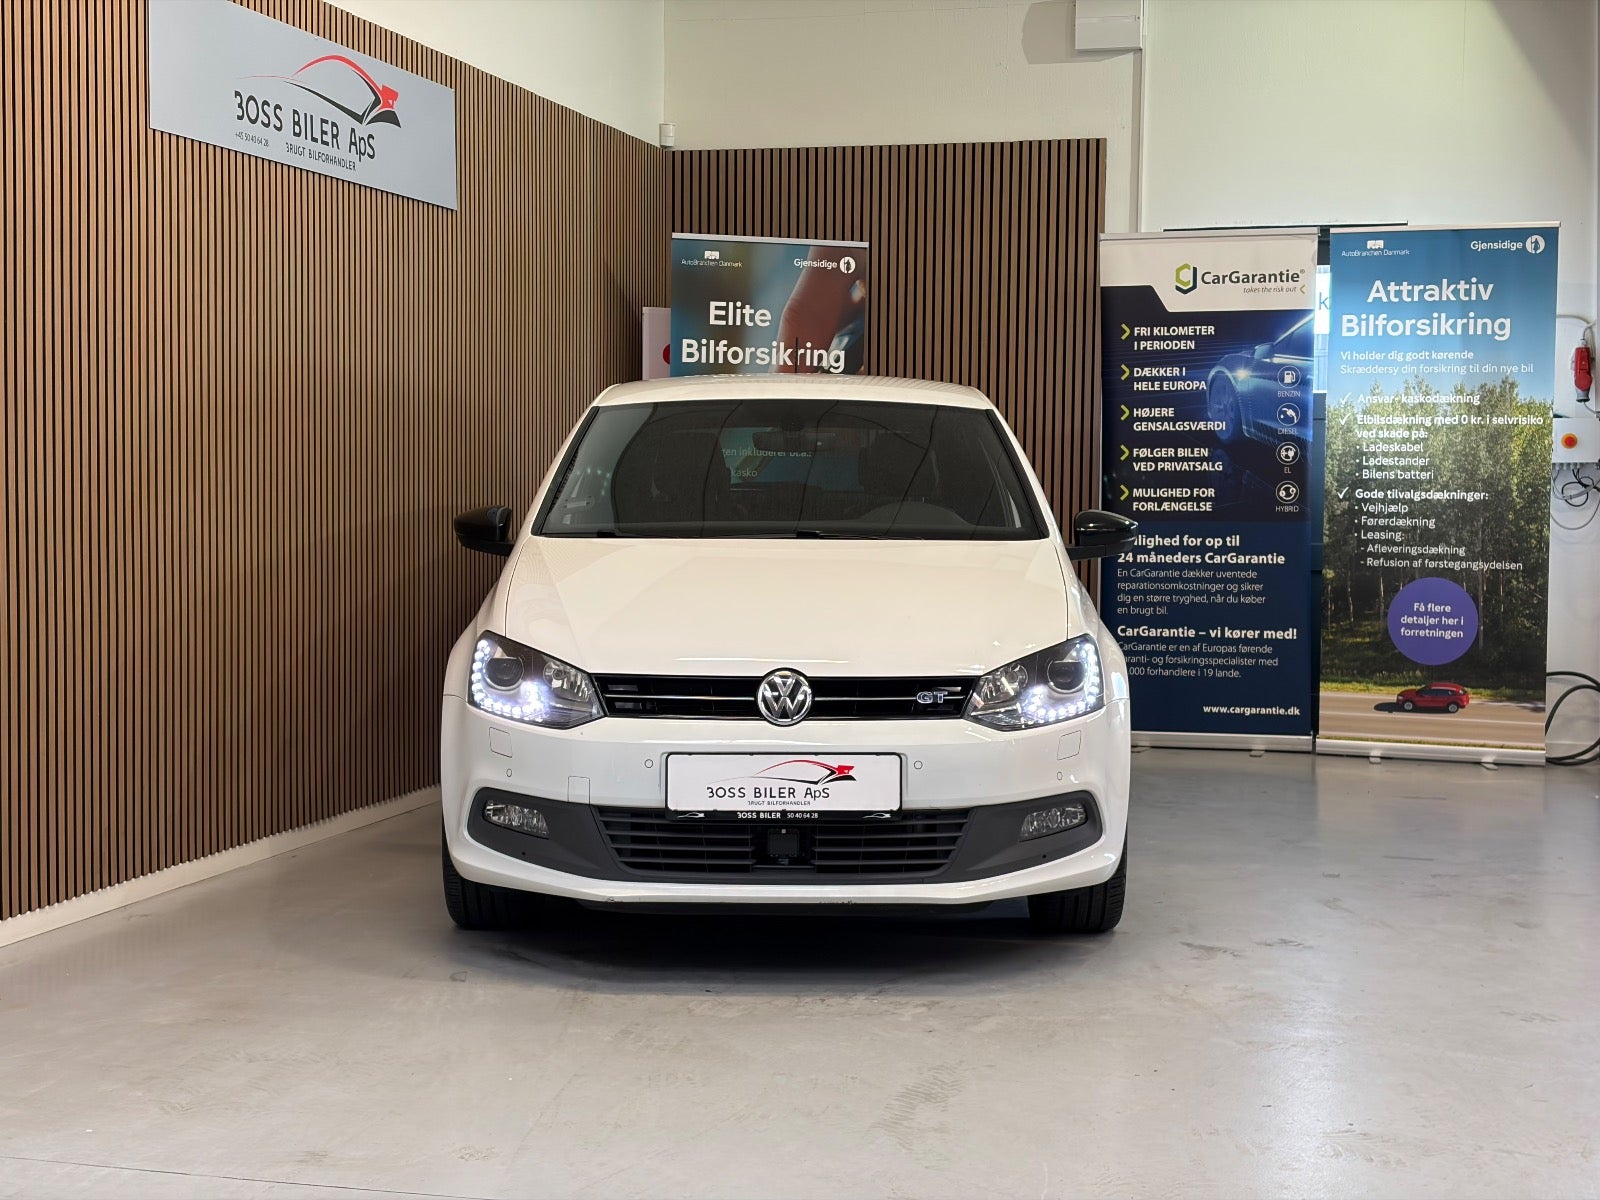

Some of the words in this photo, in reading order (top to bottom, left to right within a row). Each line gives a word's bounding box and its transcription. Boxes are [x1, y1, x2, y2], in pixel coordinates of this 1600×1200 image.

[234, 131, 243, 140] +45
[244, 133, 250, 142] 50
[257, 137, 262, 145] 64
[292, 108, 340, 150] BILER
[349, 127, 376, 162] ApS
[308, 149, 356, 171] BILFORHANDLER
[1470, 240, 1522, 251] Gjensidige
[794, 259, 837, 269] Gjensidige
[1367, 277, 1494, 303] Attraktiv
[709, 301, 771, 326] Elite
[1134, 327, 1150, 337] FRI
[1154, 326, 1214, 336] KILOMETER
[1341, 312, 1511, 340] Bilforsikring
[1134, 341, 1137, 350] I
[1140, 340, 1195, 350] PERIODEN
[682, 339, 845, 373] Bilforsikring
[1341, 351, 1351, 360] Vi
[1353, 351, 1385, 360] holder
[1388, 351, 1403, 361] dig
[1406, 351, 1429, 361] godt
[1432, 351, 1473, 359] kørende
[1134, 368, 1180, 377] DÆKKER
[1183, 368, 1185, 376] I
[1340, 365, 1398, 374] Skræddersy
[1402, 364, 1416, 373] din
[1419, 364, 1466, 374] forsikring
[1470, 364, 1479, 373] til
[1482, 364, 1497, 373] din
[1500, 366, 1518, 374] nye
[1521, 364, 1533, 373] bil
[1134, 382, 1160, 391] HELE
[1163, 381, 1206, 390] EUROPA
[1401, 394, 1480, 405] kaskodækning
[1133, 408, 1174, 418] HØJERE
[1357, 415, 1431, 426] Elbilsdækning
[1434, 415, 1458, 425] med
[1461, 415, 1468, 425] 0
[1471, 415, 1484, 425] kr.
[1486, 415, 1489, 424] i
[1493, 415, 1543, 425] selvrisiko
[1133, 422, 1225, 431] GENSALGSVÆRDI
[1357, 429, 1375, 438] ved
[1378, 429, 1408, 438] skade
[1412, 428, 1428, 440] på:
[1363, 442, 1423, 452] Ladeskabel
[1133, 448, 1175, 458] FØLGER
[1178, 448, 1208, 457] BILEN
[1133, 462, 1155, 471] VED
[1158, 462, 1223, 471] PRIVATSALG
[1363, 456, 1429, 466] Ladestander
[1363, 470, 1394, 479] Bilens
[1397, 470, 1434, 480] batteri
[1133, 488, 1190, 498] MULIGHED
[1194, 488, 1215, 497] FOR
[1356, 490, 1384, 499] Gode
[1387, 490, 1488, 502] tilvalgsdækninger:
[1133, 502, 1212, 512] FORLÆNGELSE
[1362, 503, 1408, 514] Vejhjælp
[1361, 517, 1435, 528] Førerdækning
[1361, 530, 1404, 540] Leasing:
[1183, 535, 1202, 546] for
[1206, 538, 1222, 549] op
[1226, 535, 1240, 546] til
[1367, 544, 1465, 556] Afleveringsdækning
[1118, 553, 1133, 563] 24
[1137, 552, 1201, 563] måneders
[1205, 553, 1285, 564] CarGarantie
[1367, 558, 1409, 568] Refusion
[1413, 559, 1422, 568] af
[1425, 559, 1522, 571] førstegangsydelsen
[1130, 569, 1180, 578] CarGarantie
[1182, 570, 1213, 578] dækker
[1216, 570, 1257, 579] uventede
[1118, 582, 1224, 592] reparationsomkostninger
[1118, 594, 1131, 603] dig
[1146, 594, 1170, 602] større
[1173, 594, 1208, 604] tryghed,
[1211, 595, 1224, 603] når
[1241, 595, 1265, 604] køber
[1131, 606, 1154, 616] brugt
[1156, 606, 1168, 615] bil.
[1414, 602, 1424, 612] Få
[1427, 603, 1451, 612] flere
[1401, 616, 1438, 626] detaljer
[1442, 616, 1458, 625] her
[1461, 617, 1464, 625] i
[1118, 626, 1196, 637] CarGarantie
[1210, 628, 1220, 637] vi
[1225, 627, 1260, 639] kører
[1264, 628, 1296, 639] med!
[1401, 628, 1463, 639] forretningen
[1118, 643, 1166, 651] CarGarantie
[1192, 644, 1200, 652] af
[1203, 644, 1236, 654] Europas
[1239, 644, 1272, 653] førende
[1152, 657, 1163, 665] og
[1166, 656, 1256, 666] forsikringsspecialister
[1147, 667, 1196, 676] forhandlere
[1203, 669, 1213, 677] 19
[1216, 669, 1241, 678] lande.
[917, 691, 949, 704] GT
[1203, 704, 1300, 716] www.cargarantie.dk
[753, 787, 796, 798] BILER
[804, 787, 830, 800] ApS
